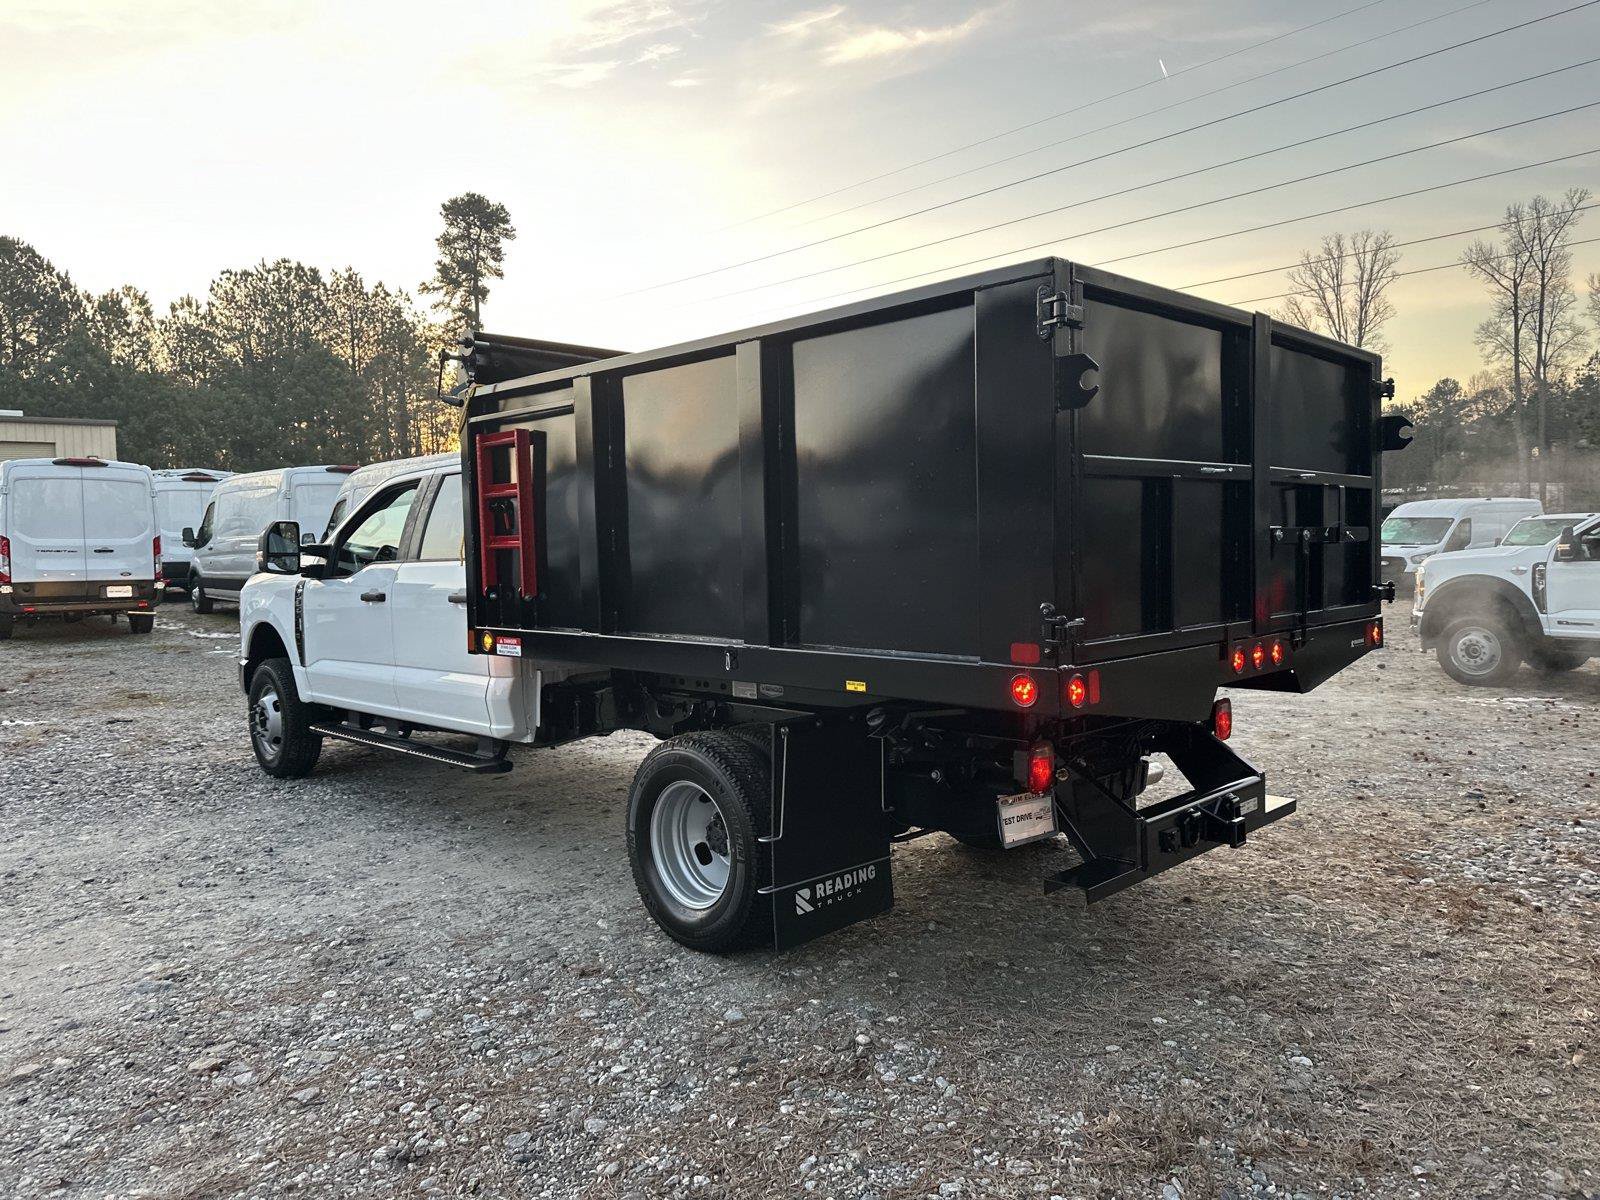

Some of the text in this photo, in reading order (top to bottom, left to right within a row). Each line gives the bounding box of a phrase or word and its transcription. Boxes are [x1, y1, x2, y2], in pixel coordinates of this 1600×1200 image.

[1016, 812, 1033, 823] DRIVE
[816, 865, 876, 899] READING
[817, 888, 862, 908] TRUCK
